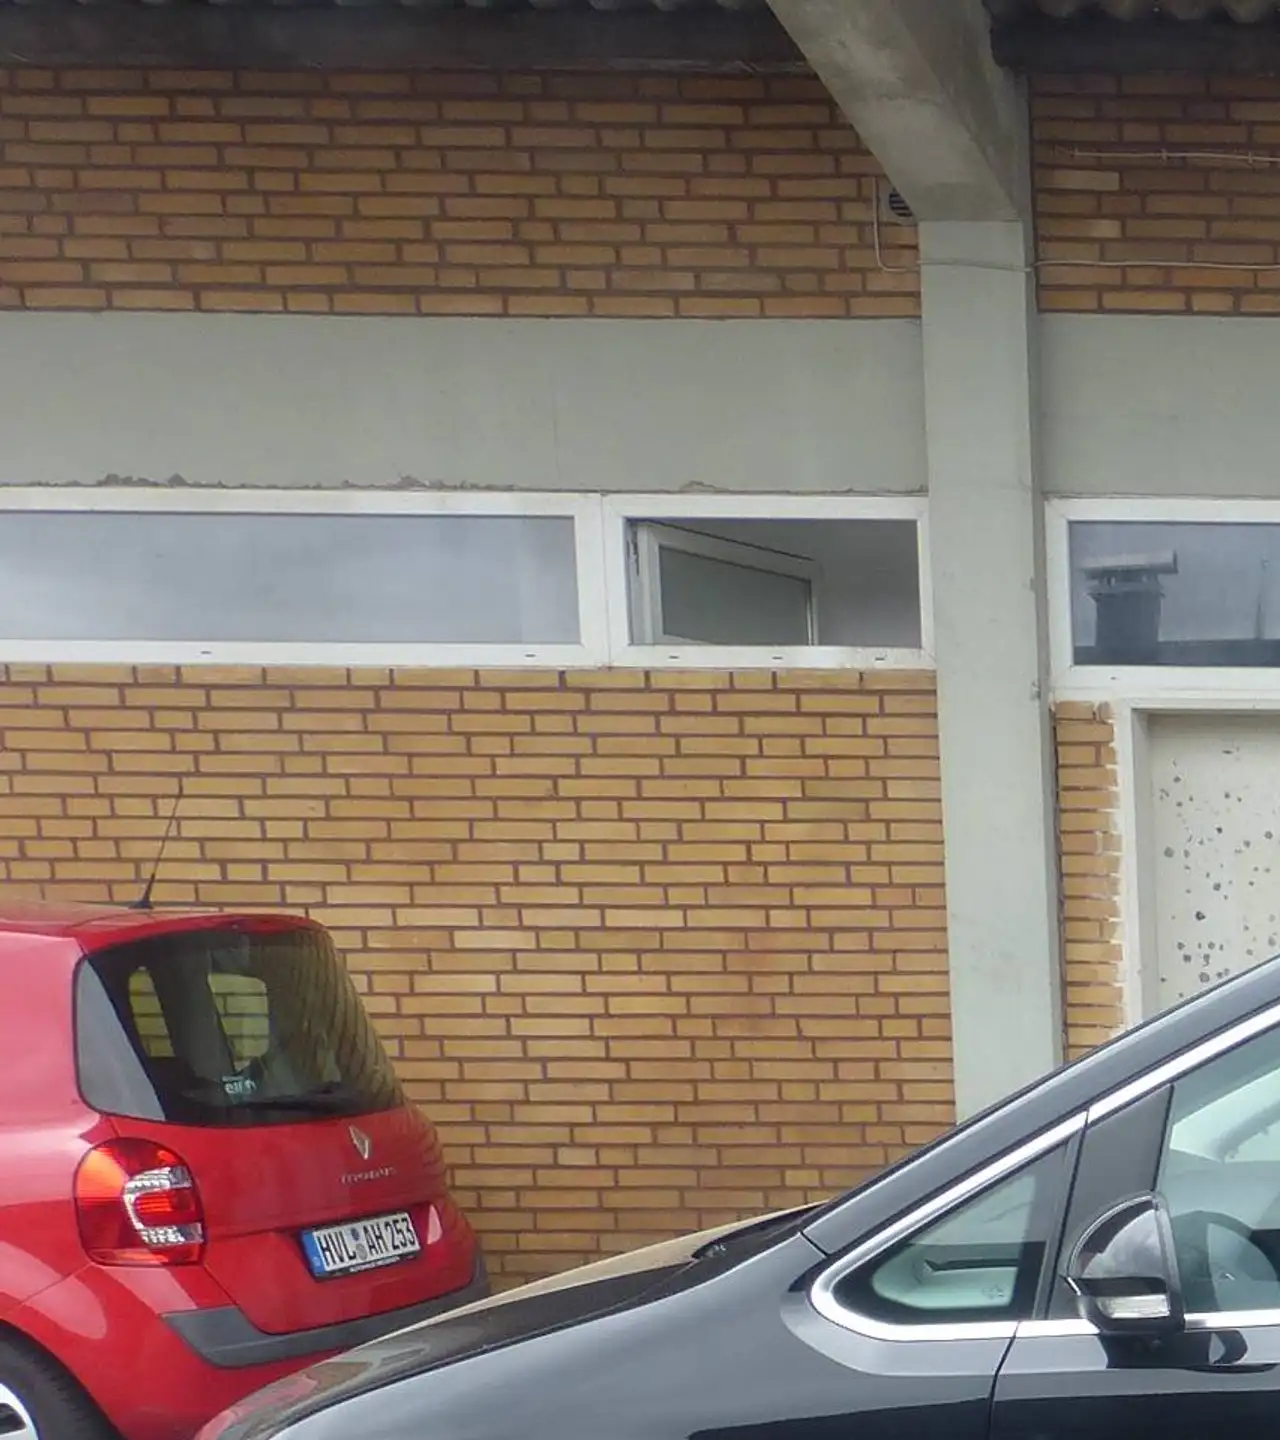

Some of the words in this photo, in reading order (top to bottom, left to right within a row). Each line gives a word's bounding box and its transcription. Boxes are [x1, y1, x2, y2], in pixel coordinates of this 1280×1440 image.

[316, 1229, 358, 1267] HVL
[363, 1222, 390, 1256] AH
[384, 1216, 416, 1250] 253
